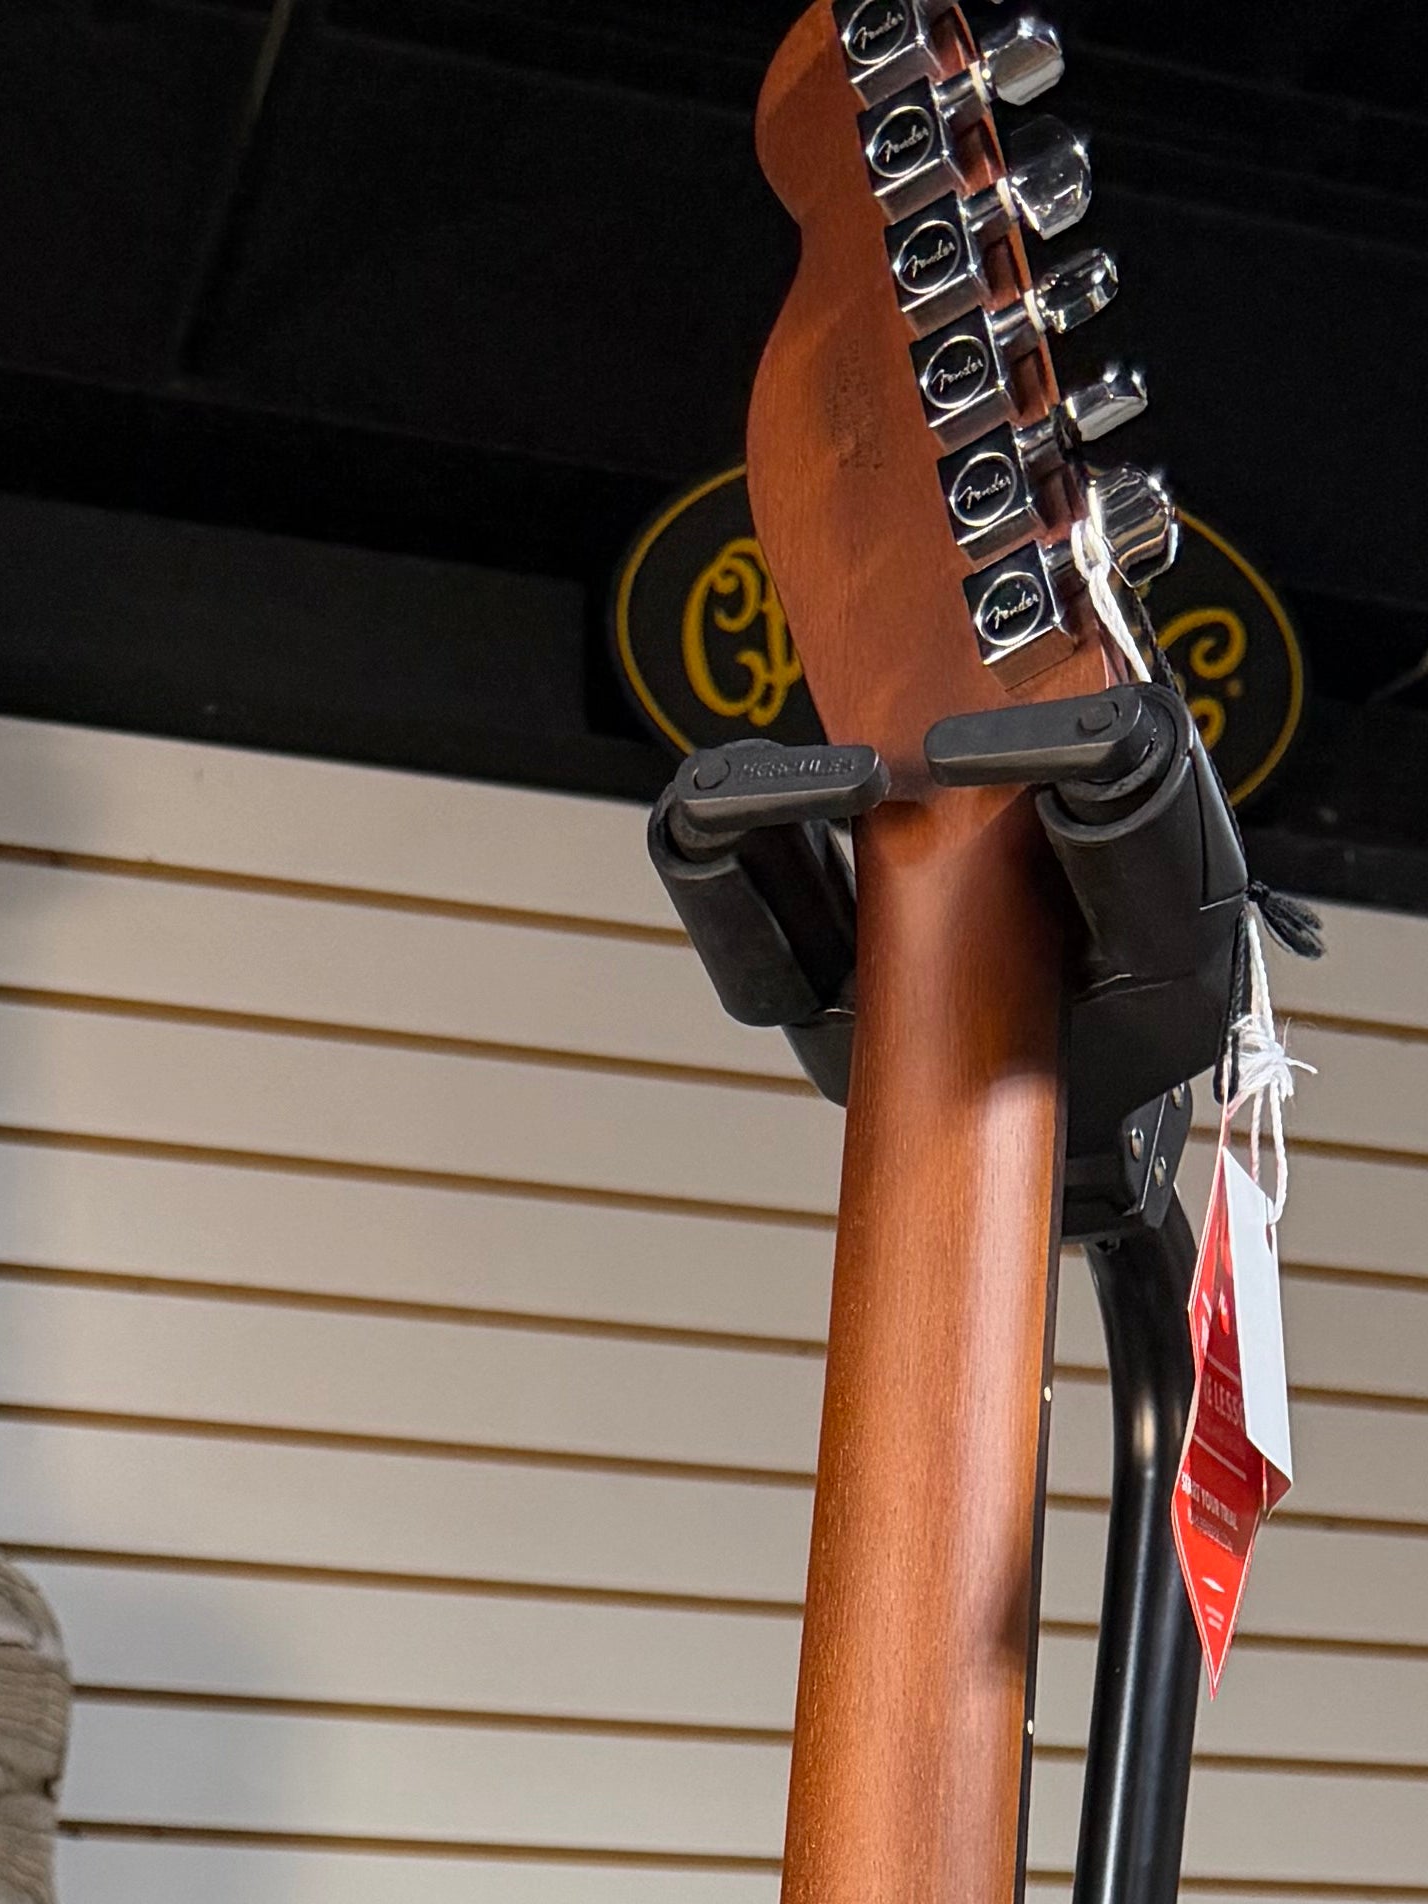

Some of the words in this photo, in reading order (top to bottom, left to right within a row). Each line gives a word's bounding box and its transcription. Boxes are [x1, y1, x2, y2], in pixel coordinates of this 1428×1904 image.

[902, 239, 956, 279] Fender
[930, 354, 984, 394] Fender
[958, 472, 1012, 510] Fender
